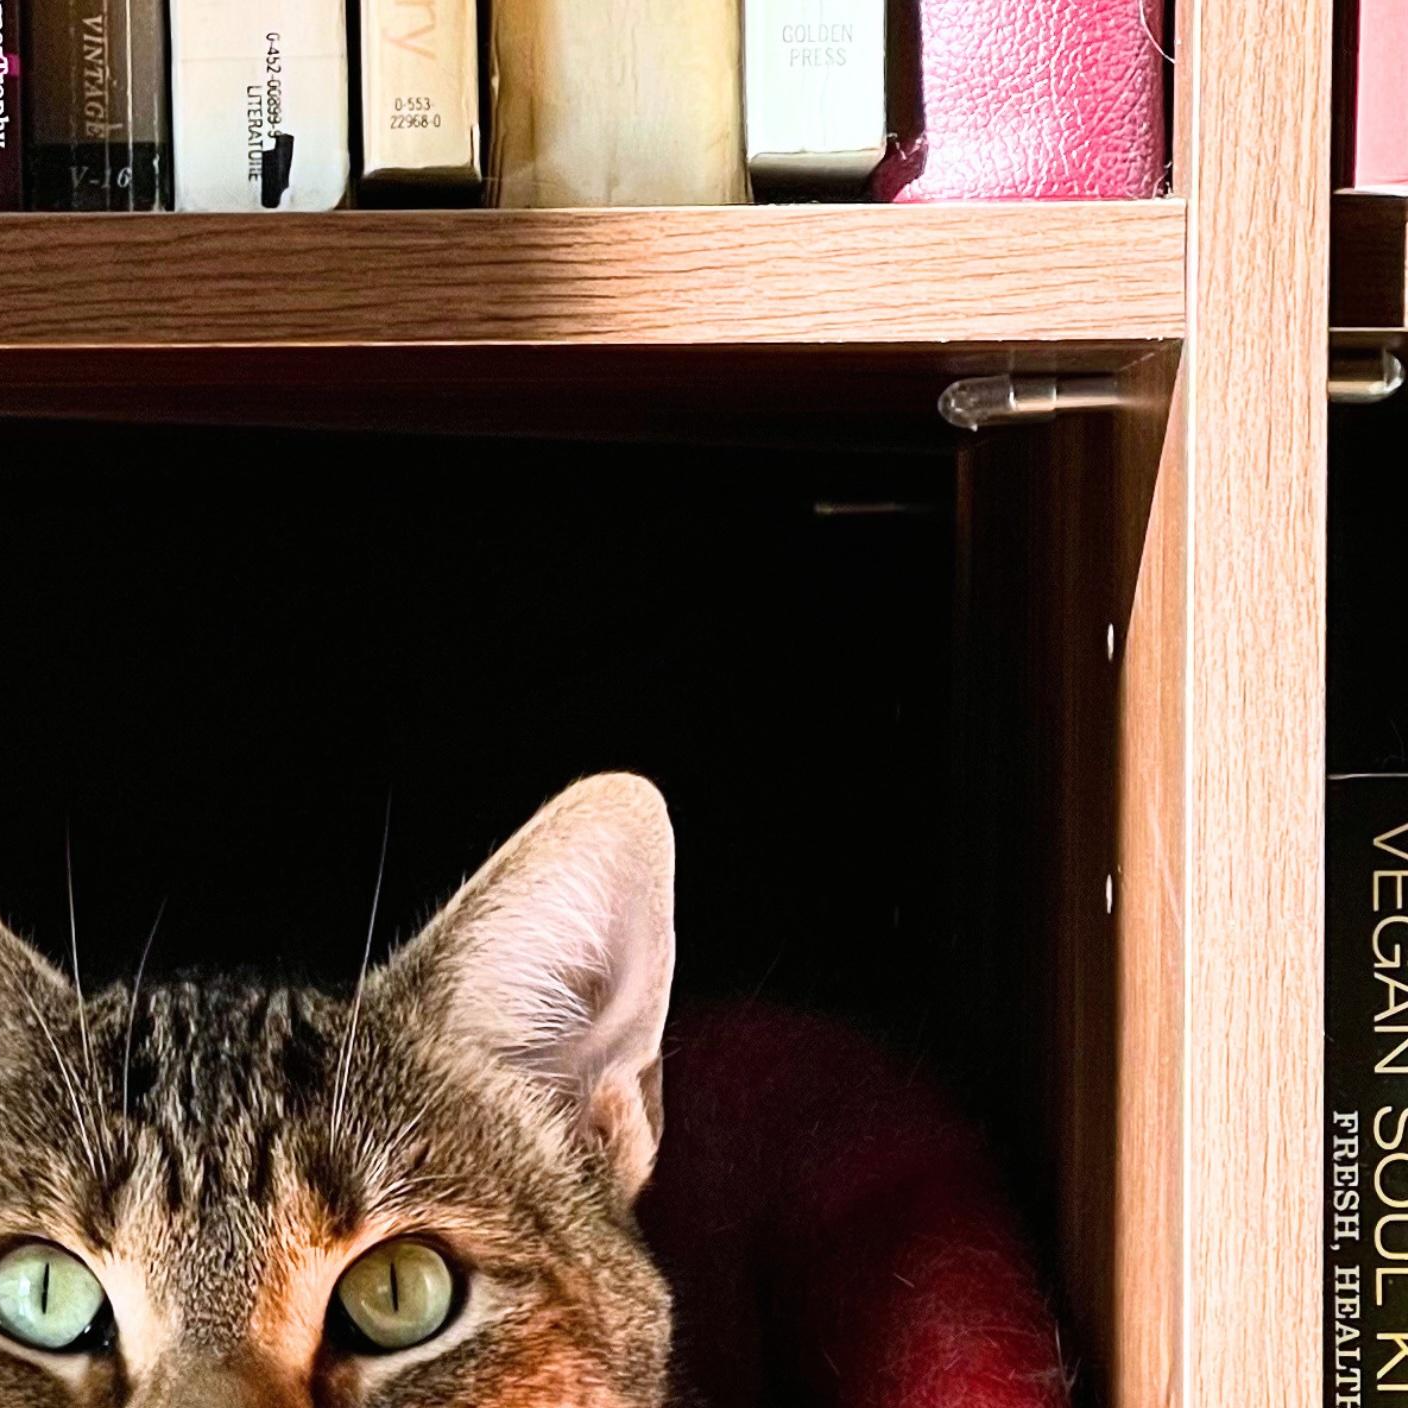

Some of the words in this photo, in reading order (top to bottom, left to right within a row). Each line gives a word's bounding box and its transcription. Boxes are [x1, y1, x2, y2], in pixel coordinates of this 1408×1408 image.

[782, 24, 853, 43] GOLDEN
[789, 47, 847, 67] PRESS
[82, 15, 106, 138] VINTAGE
[390, 115, 442, 130] 22968-0
[70, 166, 132, 188] V-16
[1373, 823, 1408, 1074] VEGAN
[1330, 1110, 1360, 1250] FRESH,
[1373, 1106, 1408, 1306] SOUL
